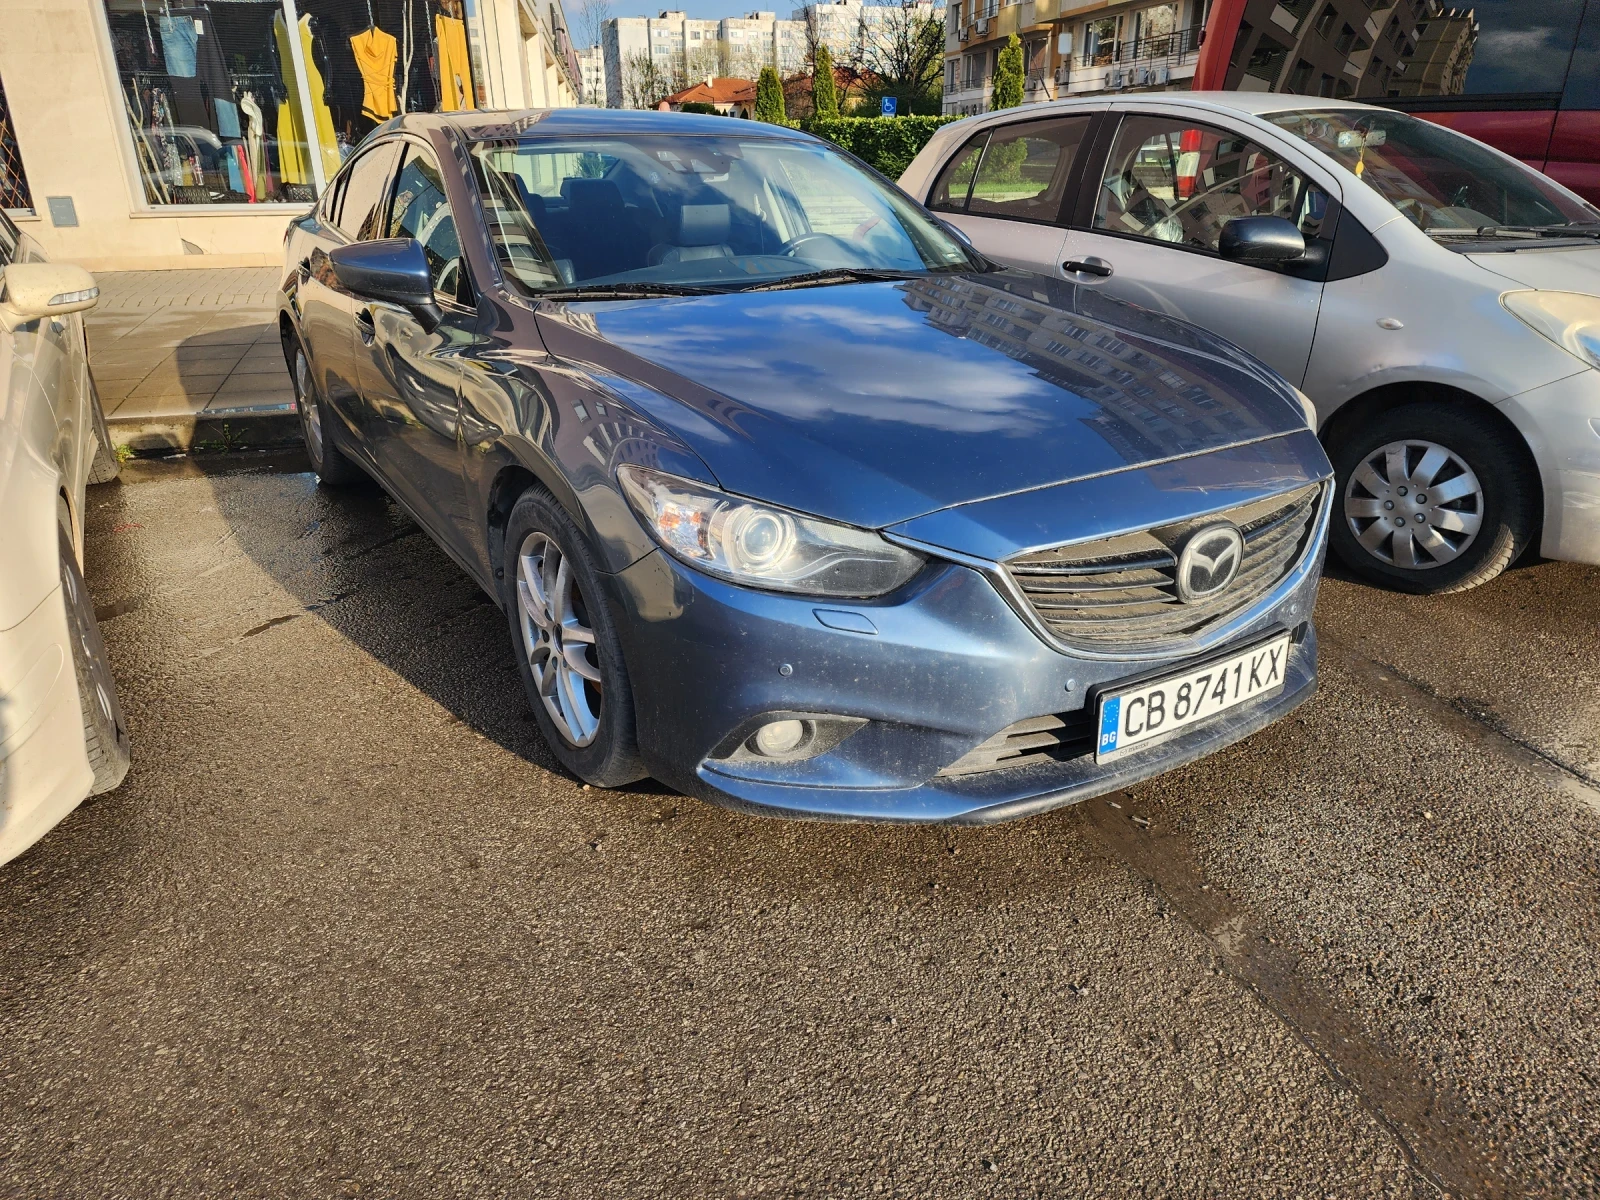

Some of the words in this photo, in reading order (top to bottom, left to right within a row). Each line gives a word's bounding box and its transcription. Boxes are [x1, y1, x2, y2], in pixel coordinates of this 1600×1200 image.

[1125, 690, 1166, 738] CB
[1174, 661, 1243, 720] 8741
[1248, 644, 1283, 693] KX
[1101, 731, 1116, 746] BG
